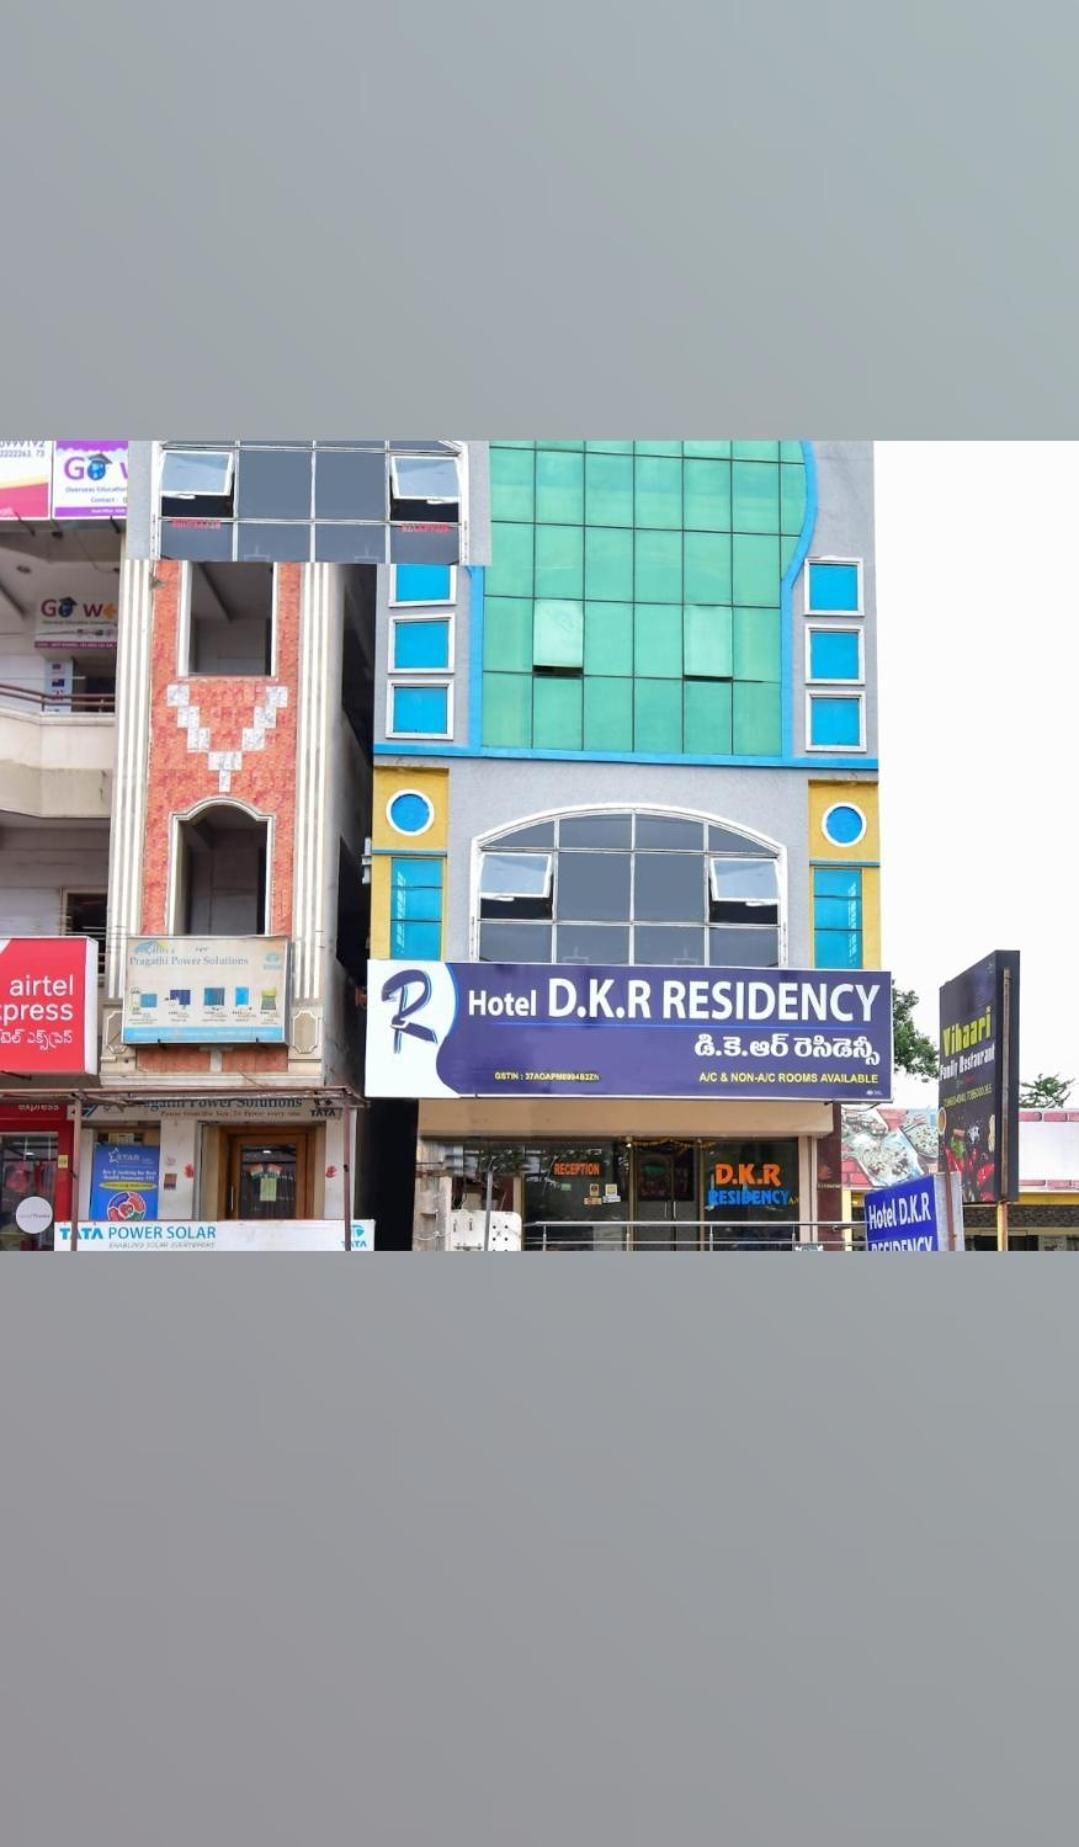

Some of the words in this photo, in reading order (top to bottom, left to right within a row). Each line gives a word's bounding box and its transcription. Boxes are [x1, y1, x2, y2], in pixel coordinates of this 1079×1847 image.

[172, 955, 200, 966] Power
[203, 954, 248, 966] Solutions
[9, 975, 74, 997] airtel
[468, 990, 537, 1016] Hotel
[548, 978, 651, 1019] D.K.R
[663, 980, 880, 1022] RESIDENCY
[0, 1003, 73, 1026] press
[943, 1006, 991, 1057] Vihaari
[494, 1072, 519, 1081] GSTIN
[699, 1072, 718, 1083] A/C
[720, 1072, 729, 1083] &
[731, 1072, 776, 1084] NON-A/C
[778, 1073, 818, 1084] ROOMS
[820, 1074, 879, 1084] AVAILABLE
[311, 1109, 336, 1117] TATA
[554, 1163, 600, 1176] RECEPTION
[715, 1163, 781, 1187] D.K.R
[709, 1190, 789, 1205] RESIDENCY
[868, 1198, 897, 1230] Hotel
[899, 1192, 931, 1225] D.K.R
[108, 1226, 163, 1240] POWER
[167, 1226, 216, 1239] SOLAR
